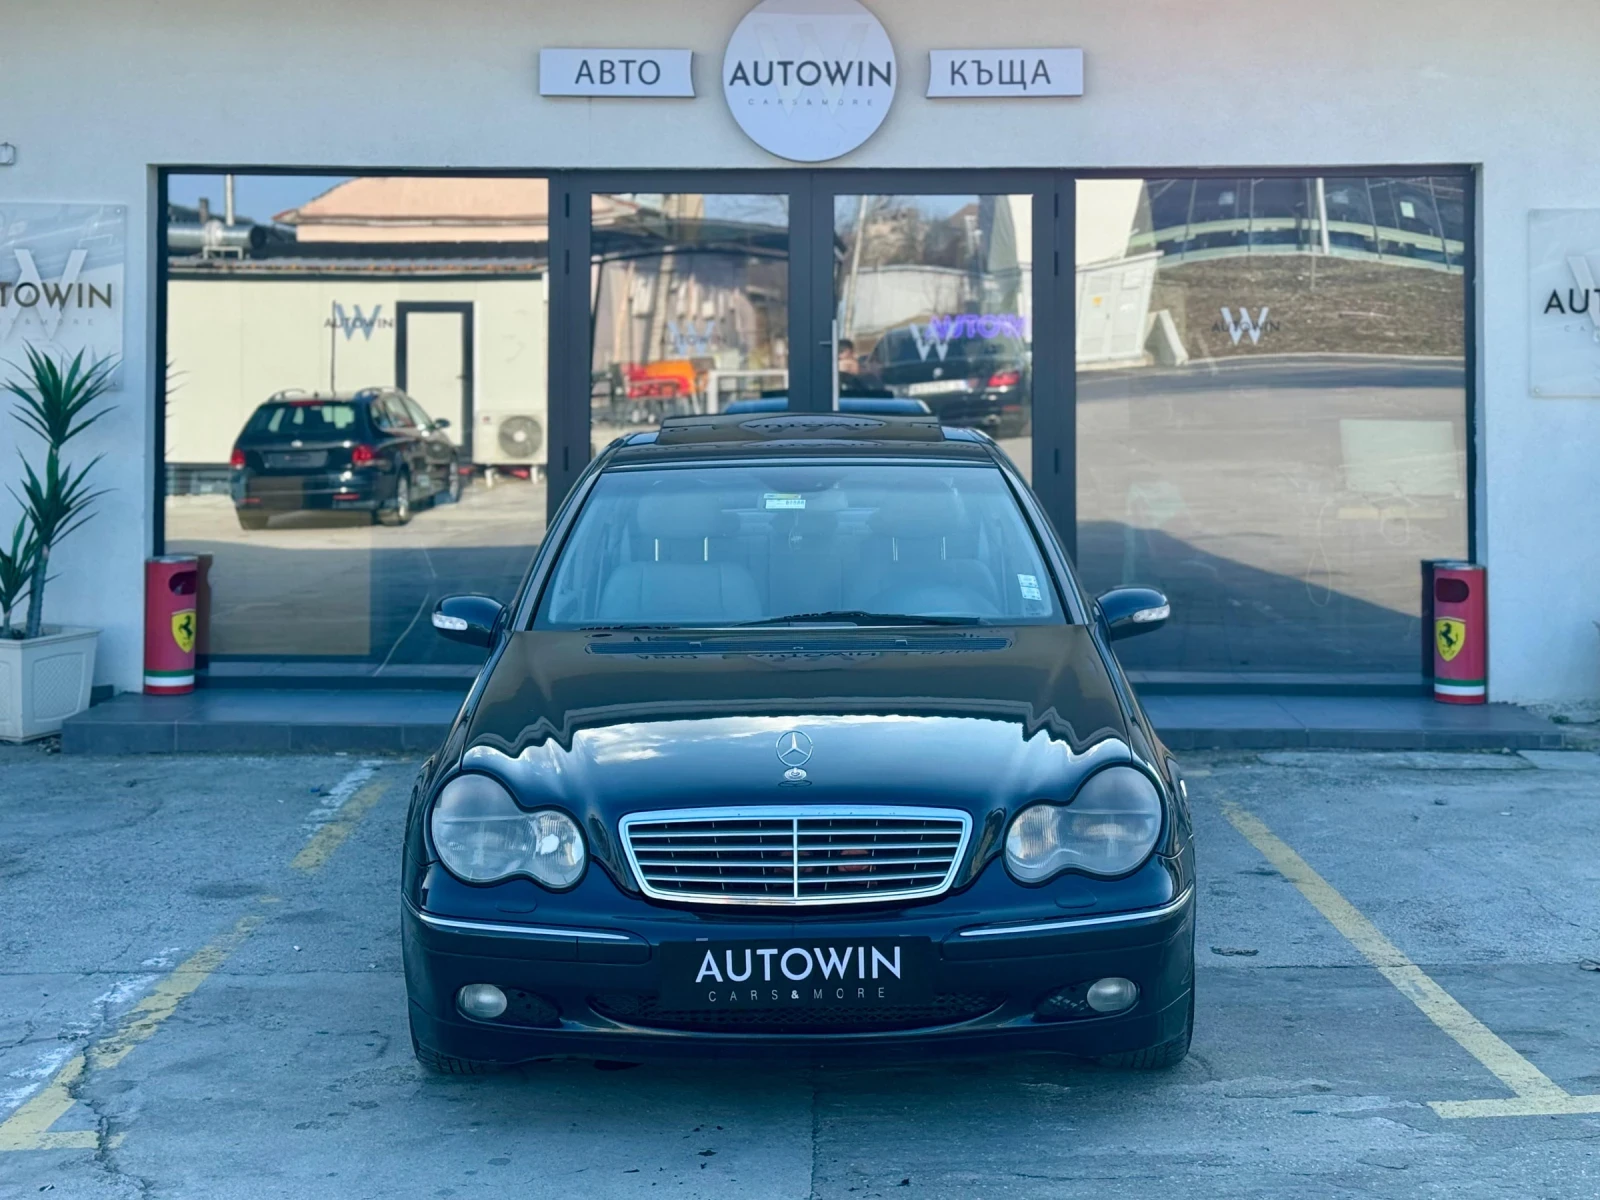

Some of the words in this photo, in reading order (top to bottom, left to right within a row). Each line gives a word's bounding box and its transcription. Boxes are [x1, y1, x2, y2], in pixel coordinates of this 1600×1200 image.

[574, 59, 661, 85] АВТО
[728, 60, 892, 87] AUTOWIN
[950, 59, 1052, 90] КЪЩА
[695, 945, 901, 983] AUTOWIN
